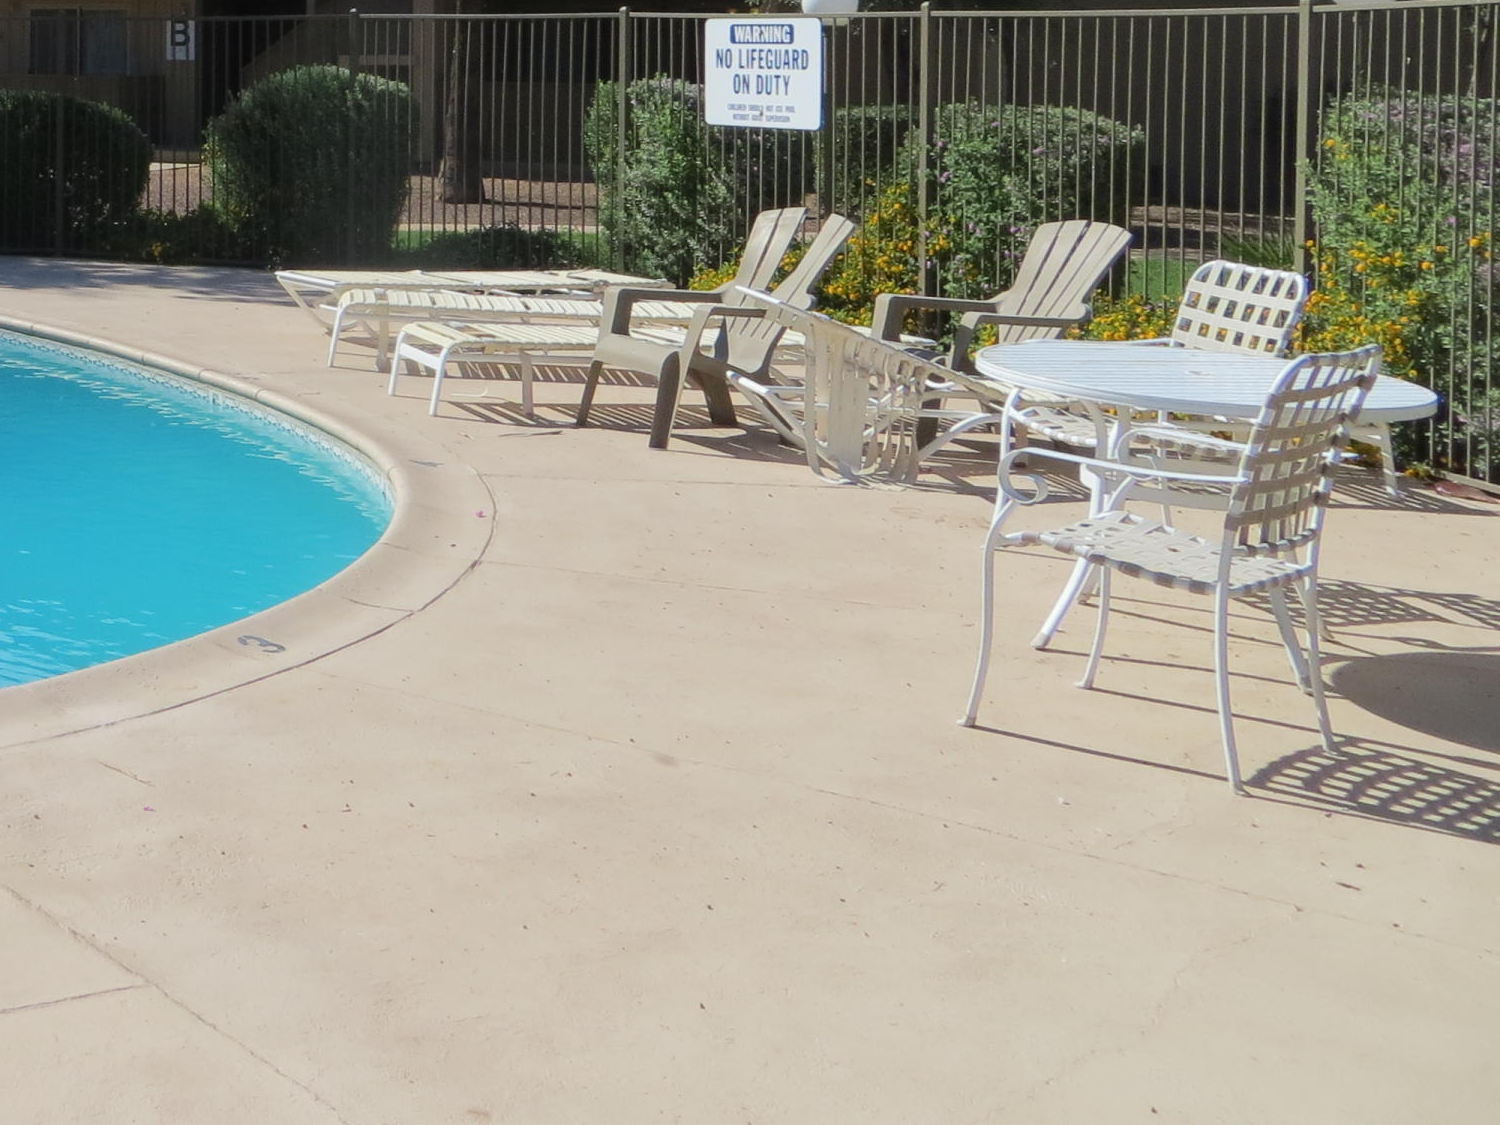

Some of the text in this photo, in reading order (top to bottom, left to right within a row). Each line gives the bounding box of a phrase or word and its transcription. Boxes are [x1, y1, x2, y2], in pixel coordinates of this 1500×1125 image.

[171, 21, 190, 46] B
[734, 24, 791, 43] WARNING
[716, 48, 809, 70] NO LIFEGUARD
[733, 73, 791, 96] ON DUTY
